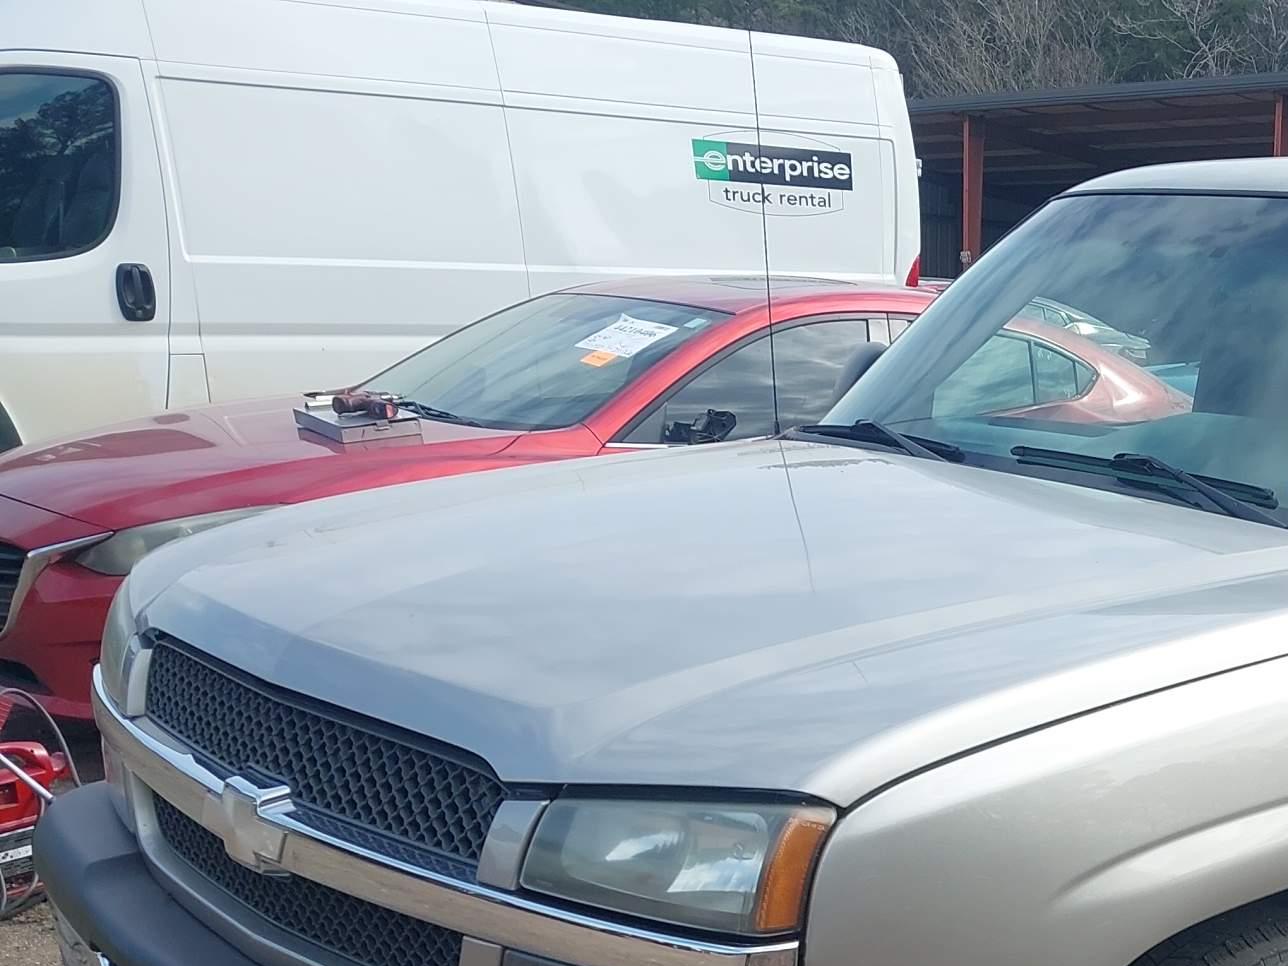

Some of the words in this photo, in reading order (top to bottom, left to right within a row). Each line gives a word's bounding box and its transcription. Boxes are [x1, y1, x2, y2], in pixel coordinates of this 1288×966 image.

[702, 149, 850, 182] enterprise
[723, 187, 773, 205] truck
[779, 191, 832, 208] rental
